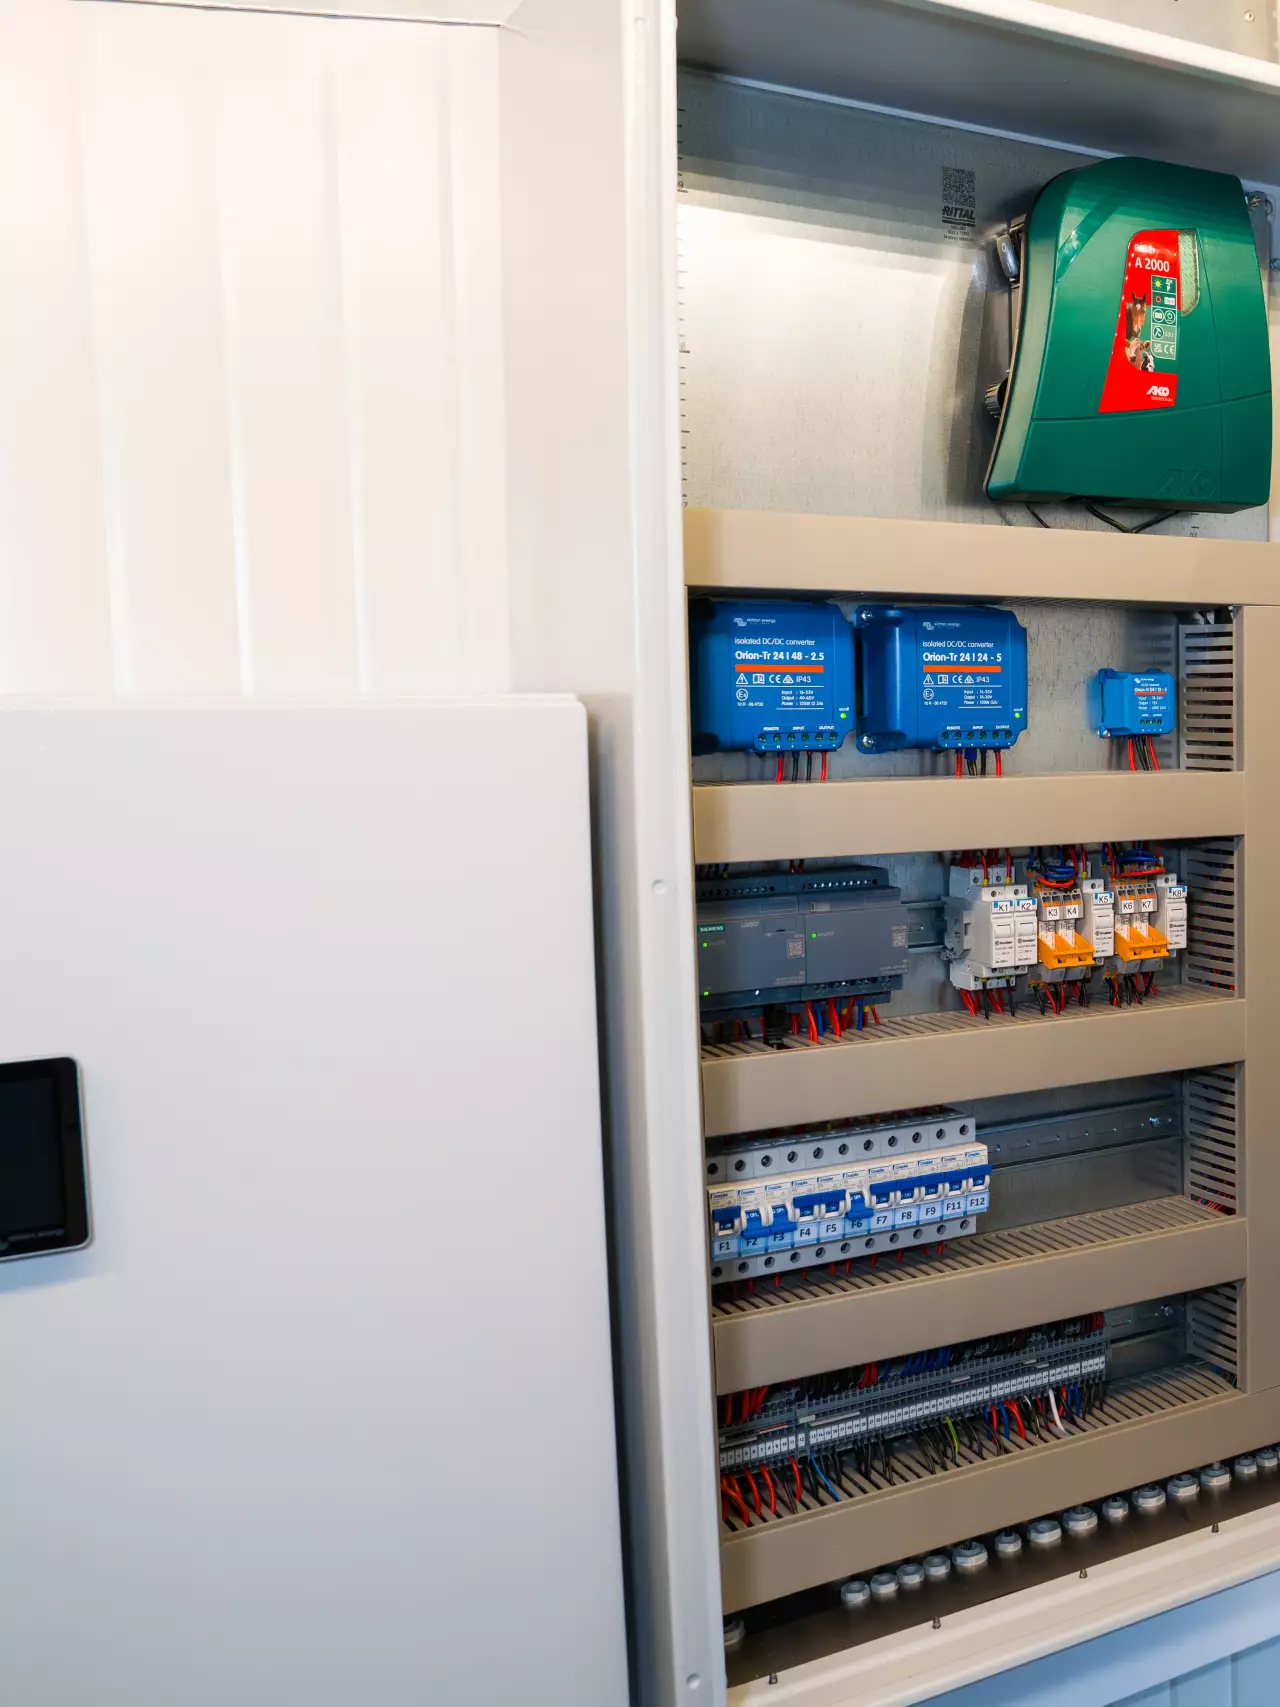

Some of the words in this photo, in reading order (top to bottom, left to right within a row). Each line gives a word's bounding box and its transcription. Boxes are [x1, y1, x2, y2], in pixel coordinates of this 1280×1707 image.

[942, 206, 975, 220] RITTAL
[1135, 257, 1142, 268] A
[1145, 257, 1170, 272] 2000
[1146, 386, 1170, 397] AKO
[735, 651, 771, 660] Orion-Tr
[773, 651, 784, 660] 24
[791, 652, 802, 660] 48
[811, 652, 824, 660] 2.5
[923, 652, 958, 662] Orion-Tr
[960, 653, 970, 662] 24
[977, 653, 988, 662] 24
[996, 653, 1002, 662] 5
[1173, 889, 1182, 897] K8
[1099, 896, 1108, 904] K5
[1123, 902, 1132, 910] K6
[946, 1201, 961, 1211] F11
[969, 1197, 985, 1207] F12
[901, 1211, 912, 1220] F8
[925, 1206, 936, 1216] F9
[851, 1220, 863, 1229] F6
[876, 1215, 888, 1224] F7
[799, 1228, 811, 1237] F4
[826, 1223, 837, 1233] F5
[773, 1232, 785, 1242] F3
[719, 1241, 730, 1251] F1
[746, 1238, 757, 1247] F2
